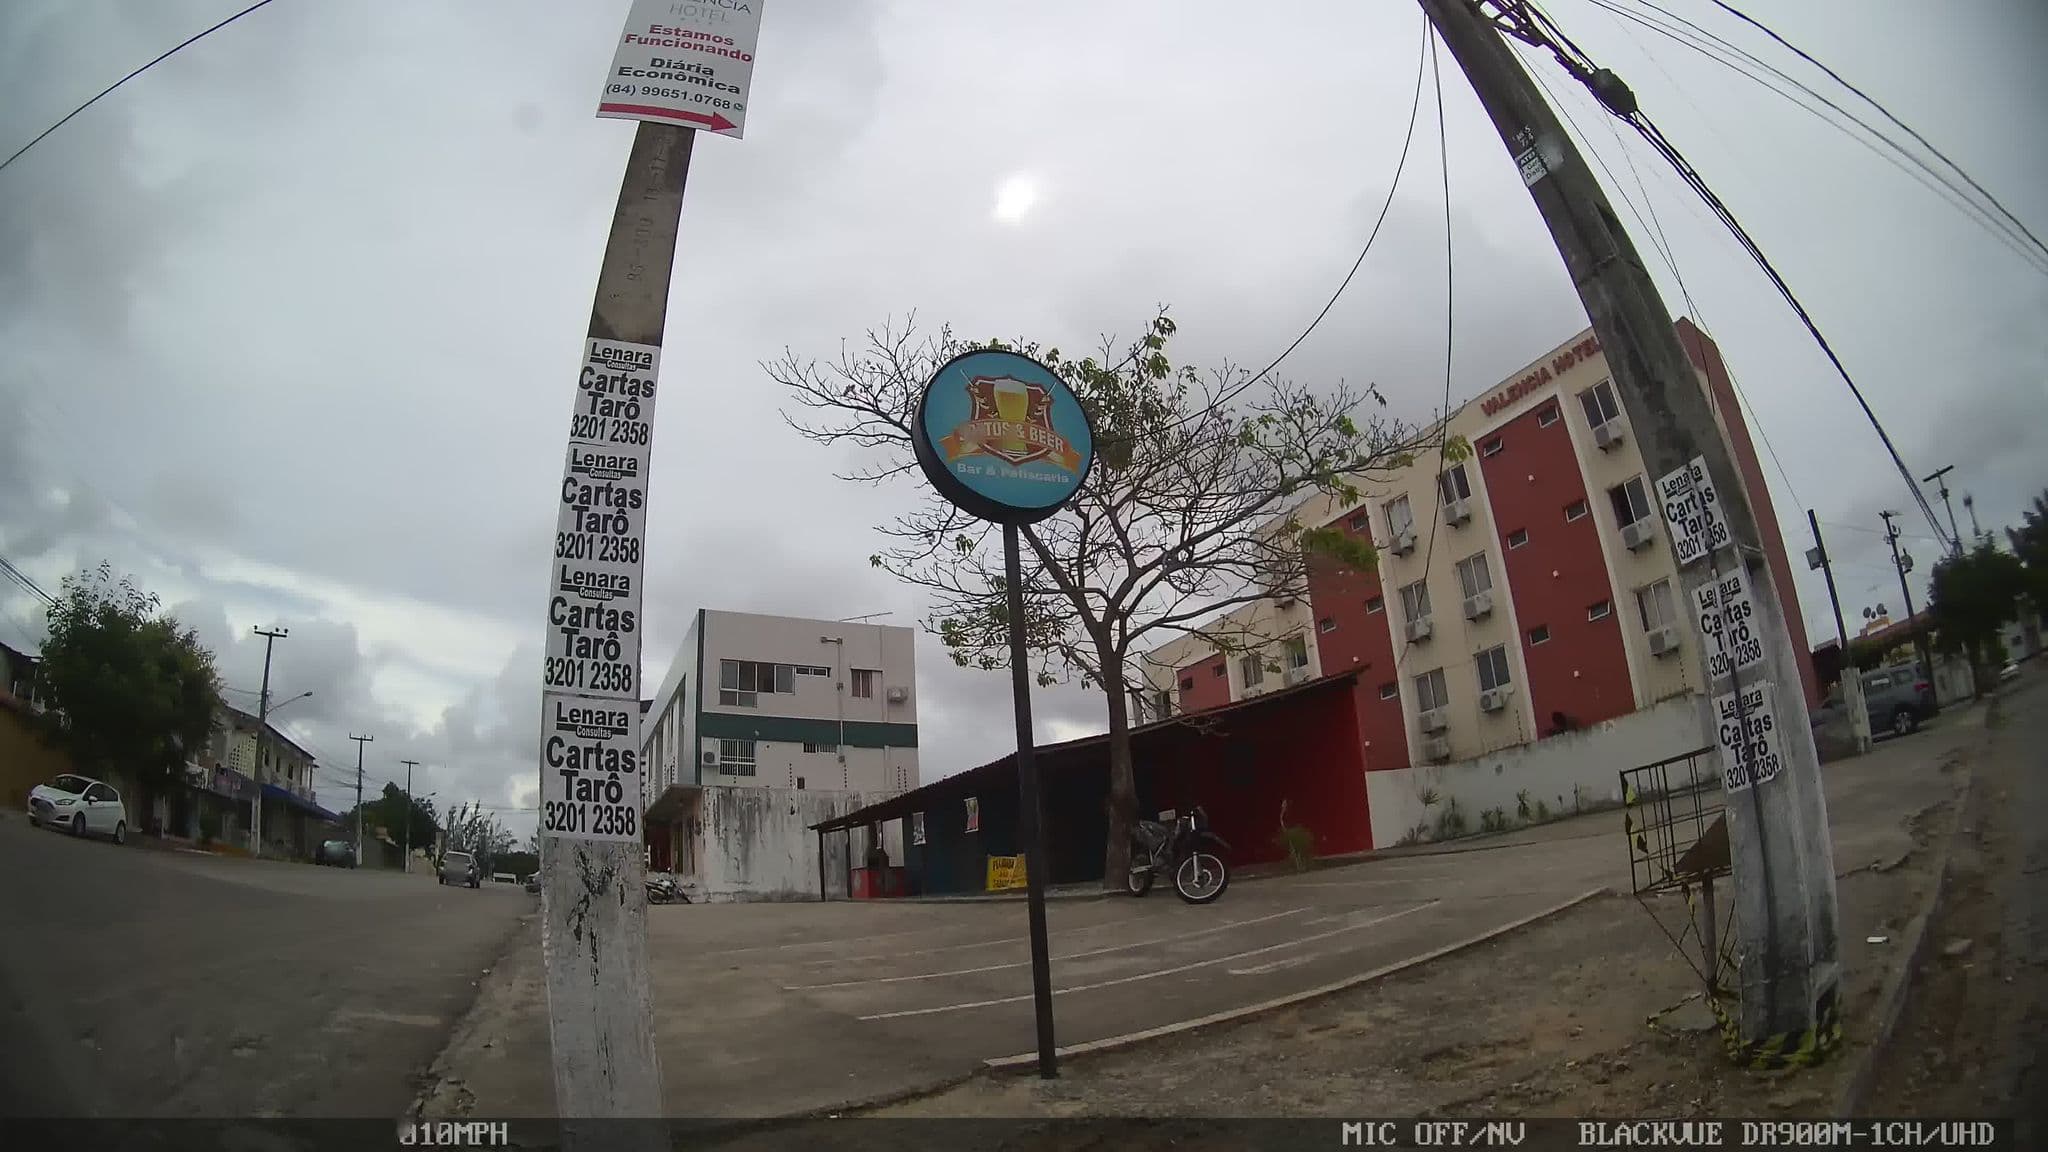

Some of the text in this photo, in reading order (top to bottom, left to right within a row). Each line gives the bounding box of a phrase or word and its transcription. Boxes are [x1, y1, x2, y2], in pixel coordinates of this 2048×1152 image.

[669, 4, 728, 22] HOTEL
[624, 34, 752, 62] Funcionando
[649, 24, 734, 46] Estamos
[617, 66, 741, 94] Econômica
[650, 57, 714, 76] Diária
[606, 83, 730, 110] (84) 99651.0768
[591, 342, 653, 364] Lenara
[579, 366, 655, 398] Cartas
[587, 391, 640, 420] Tarô
[571, 414, 649, 446] 3201 2358
[1029, 426, 1064, 452] BEER
[572, 448, 638, 471] Lenara
[957, 463, 982, 475] Bar
[562, 477, 642, 509] Cartas
[572, 505, 629, 535] Tarô
[556, 532, 640, 563] 3201 2358
[1678, 535, 1701, 560] 3201
[561, 564, 630, 591] Lenara
[1698, 577, 1740, 604] Leara
[550, 596, 635, 633] Cartas
[1701, 600, 1752, 634] Catas
[561, 627, 621, 661] Tarô
[1710, 638, 1761, 676] 320 2358
[545, 657, 632, 692] 3201 2358
[556, 702, 629, 728] Lenara
[1720, 690, 1763, 714] Leara
[1720, 714, 1772, 746] Catas
[546, 736, 636, 773] Cartas
[1754, 753, 1779, 780] 2358
[560, 770, 623, 804] Tarô
[545, 801, 636, 836] 3201 2358
